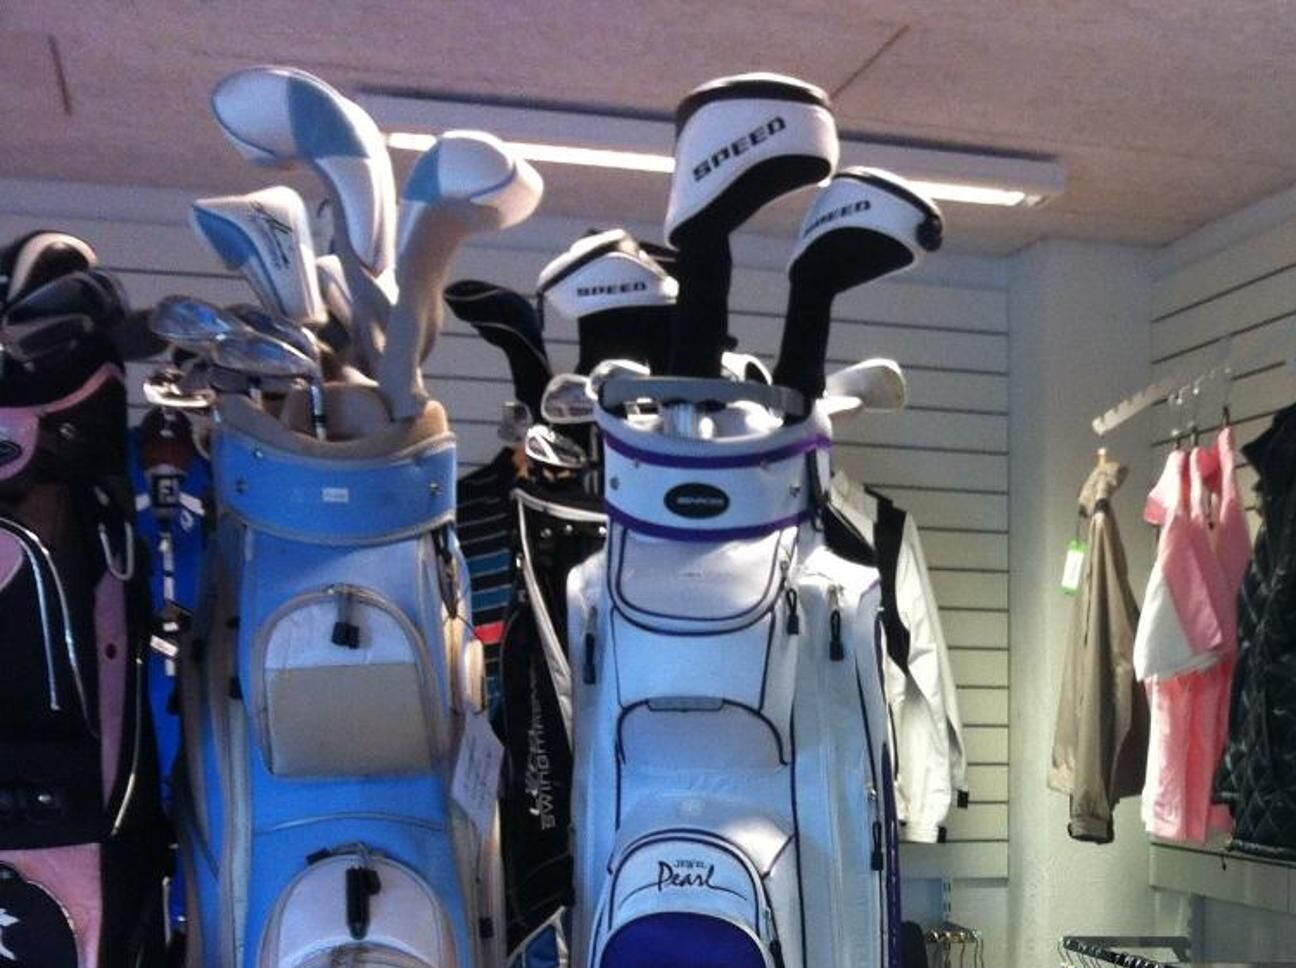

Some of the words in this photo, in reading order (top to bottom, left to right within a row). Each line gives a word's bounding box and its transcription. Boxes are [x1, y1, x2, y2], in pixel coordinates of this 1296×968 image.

[692, 116, 786, 182] SPEED
[577, 281, 647, 297] SPEED
[657, 861, 716, 893] Pearl
